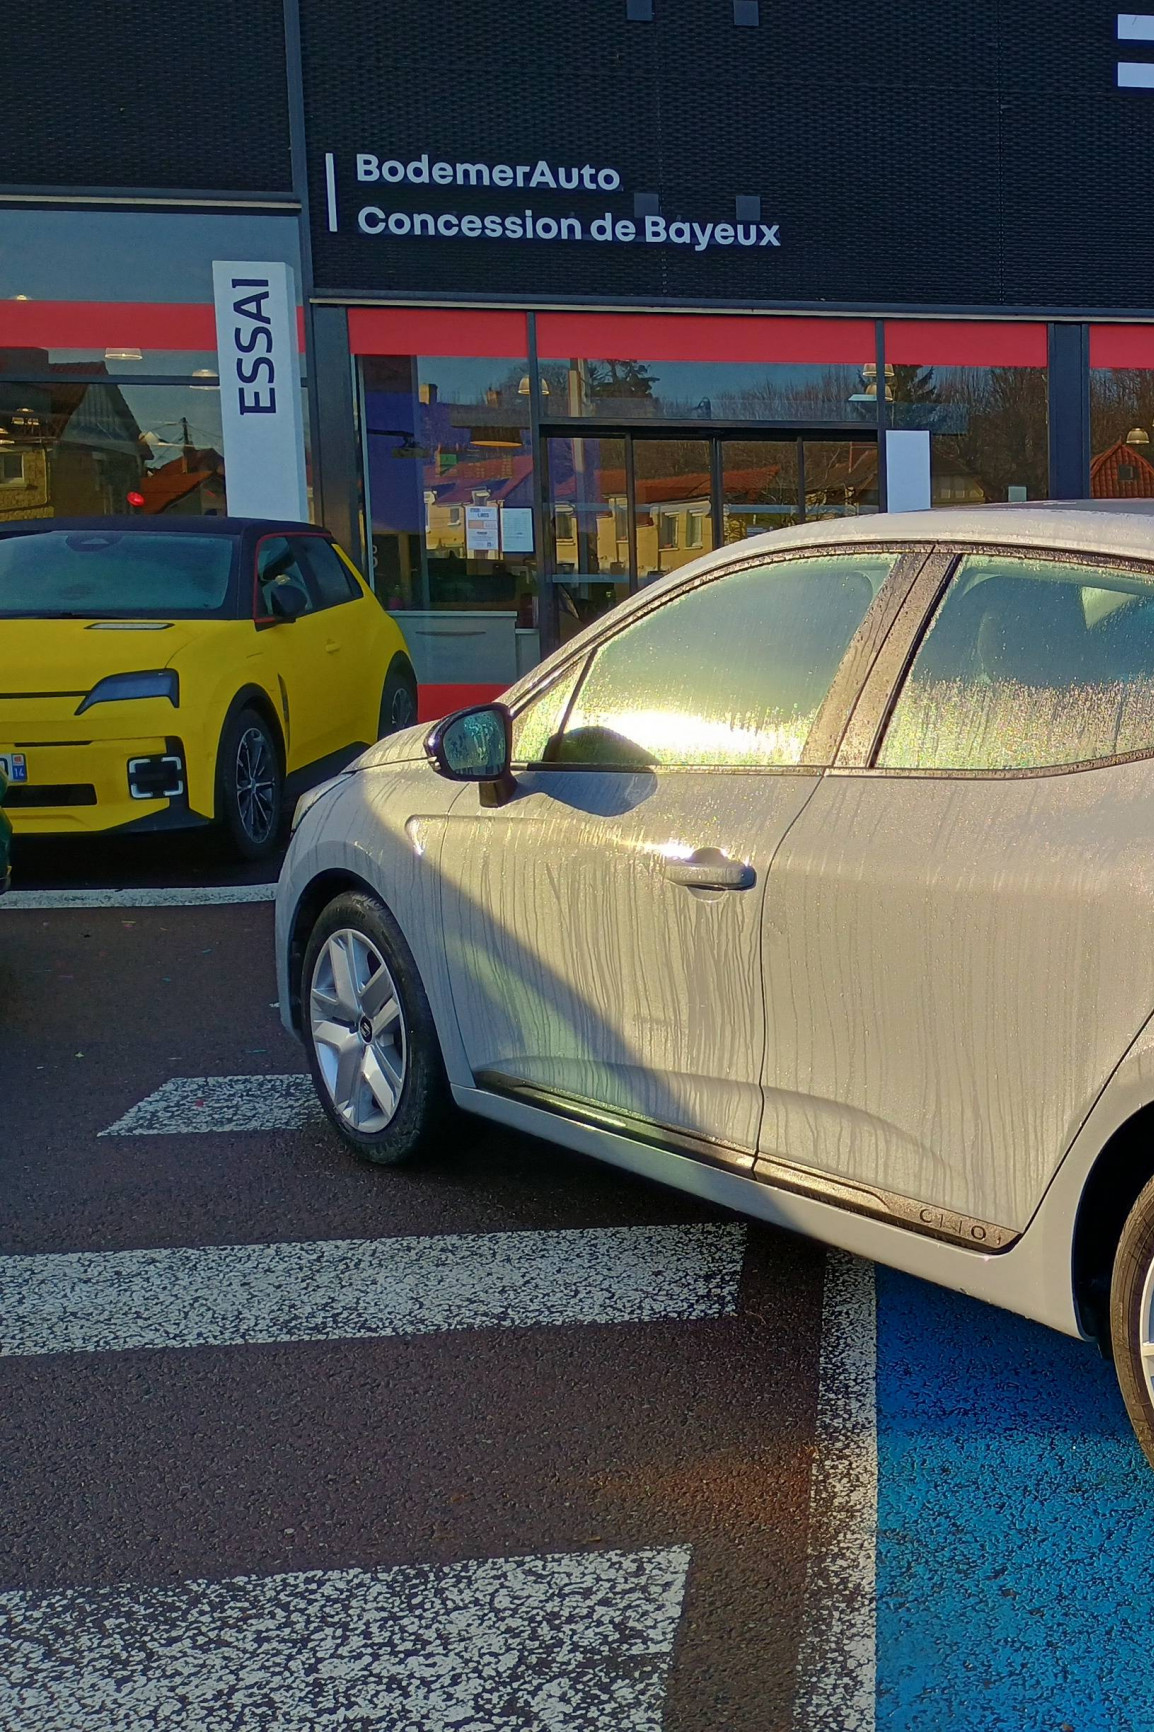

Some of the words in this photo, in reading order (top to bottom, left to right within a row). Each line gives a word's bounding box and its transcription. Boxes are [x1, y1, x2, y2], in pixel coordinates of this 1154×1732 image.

[356, 153, 620, 191] BodemerAuto
[357, 206, 581, 240] Concession
[589, 212, 636, 242] de
[644, 215, 781, 252] Bayeux
[231, 278, 277, 416] ESSAI
